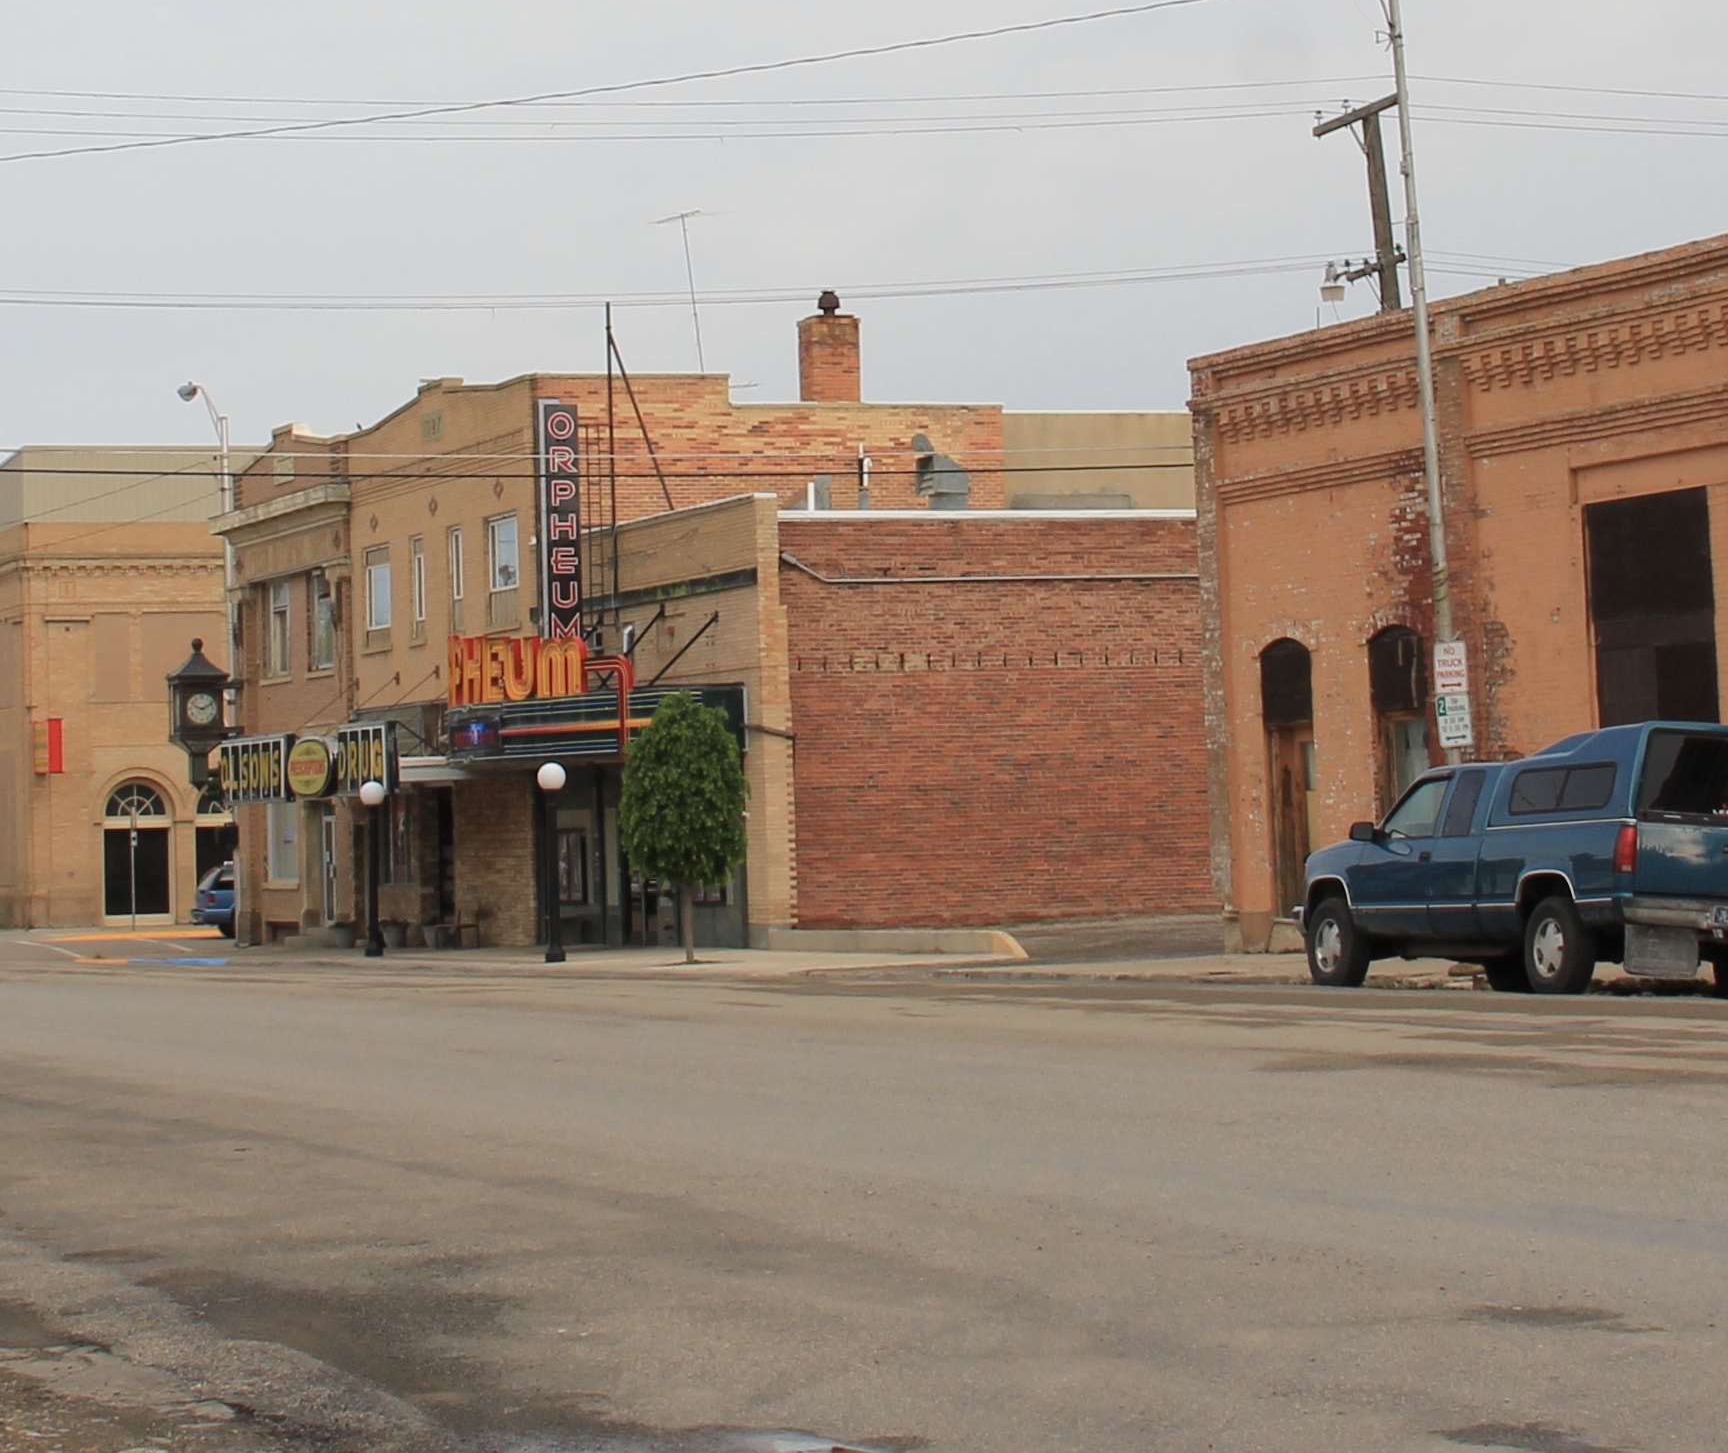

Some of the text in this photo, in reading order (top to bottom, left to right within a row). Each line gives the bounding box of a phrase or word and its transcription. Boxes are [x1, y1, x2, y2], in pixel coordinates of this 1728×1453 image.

[547, 411, 580, 639] ORPHEUM
[1443, 647, 1455, 655] NO
[1436, 658, 1463, 668] TRUCK
[1436, 670, 1466, 679] PARKING
[1438, 698, 1445, 714] 2
[338, 738, 382, 781] DRUG
